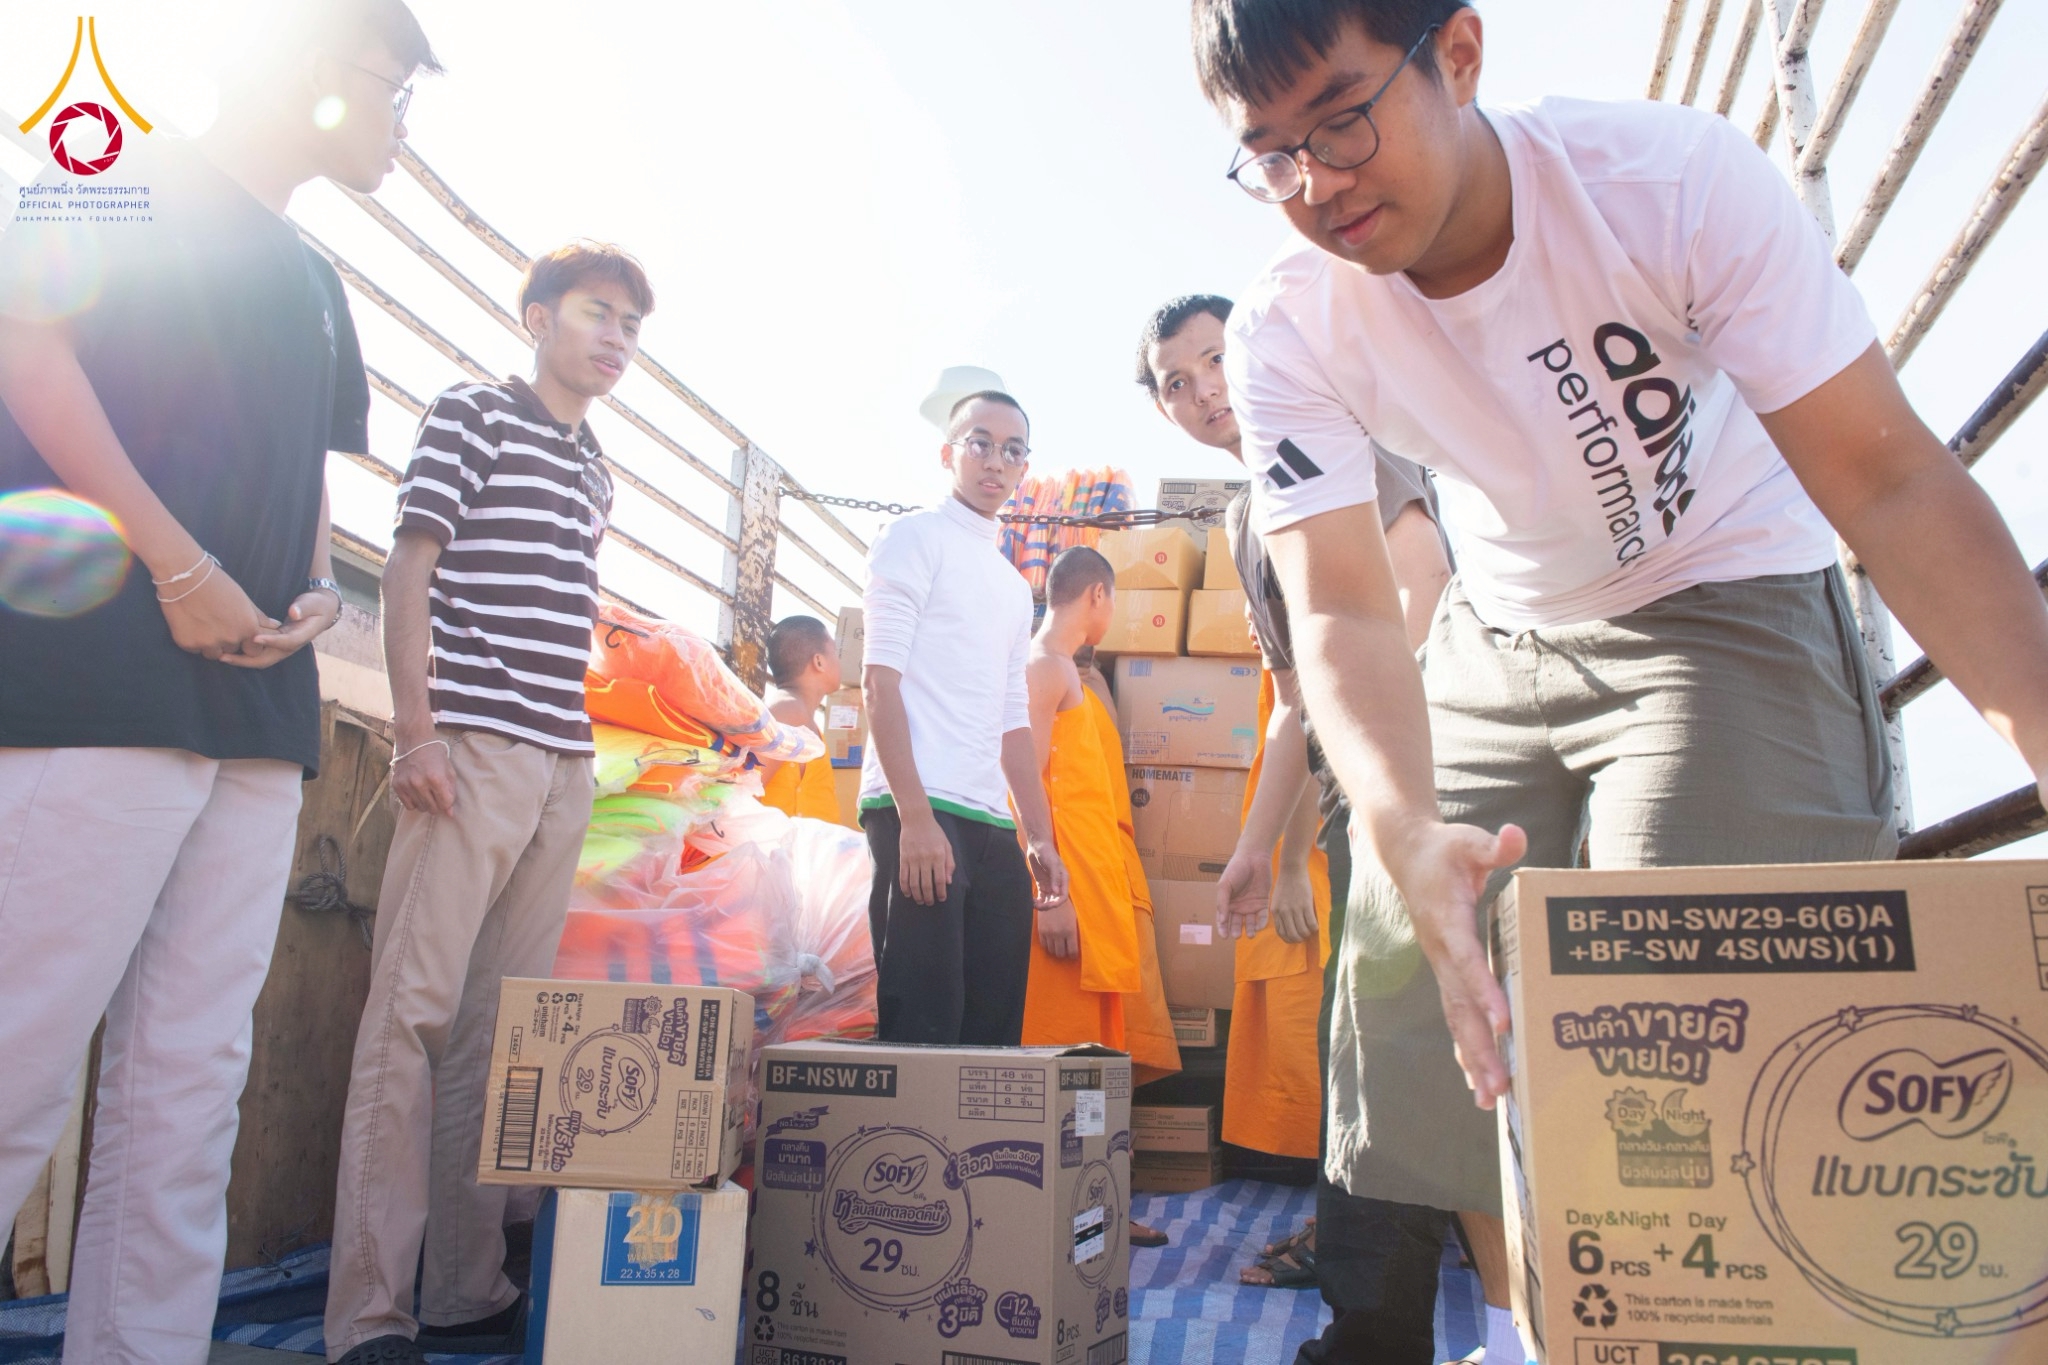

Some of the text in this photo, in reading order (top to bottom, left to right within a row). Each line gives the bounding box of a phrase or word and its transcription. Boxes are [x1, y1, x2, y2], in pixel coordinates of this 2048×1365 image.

[1132, 768, 1192, 782] HOMEMATE
[1567, 905, 1893, 932] BF-DN-SW29-6(6)A
[1569, 936, 1896, 964] +BF-SW 4S(WS)(1)
[565, 992, 578, 1003] 6
[539, 1006, 549, 1038] unicharm
[562, 1022, 574, 1032] 4
[670, 1000, 686, 1064] สินค้าขายดี
[1561, 1006, 1742, 1046] สินค้าขายดี
[1597, 1039, 1704, 1079] ขายไว!
[576, 1066, 594, 1094] 29
[621, 1065, 640, 1102] SOFY
[772, 1065, 892, 1090] BF-NSW 8T
[1001, 1071, 1015, 1079] 48
[1061, 1072, 1089, 1086] BF-NSW
[1005, 1084, 1012, 1092] 6
[1865, 1069, 1978, 1121] SOFY
[1004, 1097, 1012, 1105] 8
[1618, 1106, 1646, 1121] Day
[1666, 1108, 1706, 1124] Night
[778, 1153, 811, 1165] มามาก
[959, 1155, 992, 1178] ล็อค
[873, 1161, 917, 1188] SOFY
[1566, 1209, 1727, 1232] Day&Night Day
[860, 1238, 903, 1273] 29
[1568, 1230, 1605, 1277] 6
[1610, 1260, 1651, 1278] PCS
[1682, 1233, 1720, 1279] 4
[1726, 1263, 1768, 1280] PCS
[1894, 1220, 1978, 1280] 29
[620, 1268, 633, 1279] 22
[644, 1269, 657, 1279] 35
[667, 1269, 680, 1279] 28
[756, 1270, 819, 1319] 8 ชิ้น
[1625, 1293, 1774, 1310] This carton is made from
[941, 1304, 979, 1333] 3 มิติ
[1013, 1298, 1028, 1316] 12
[1627, 1309, 1773, 1326] 100% recycled materials
[1057, 1318, 1064, 1346] 8
[759, 1348, 776, 1357] UCT
[1594, 1345, 1639, 1365] UCT
